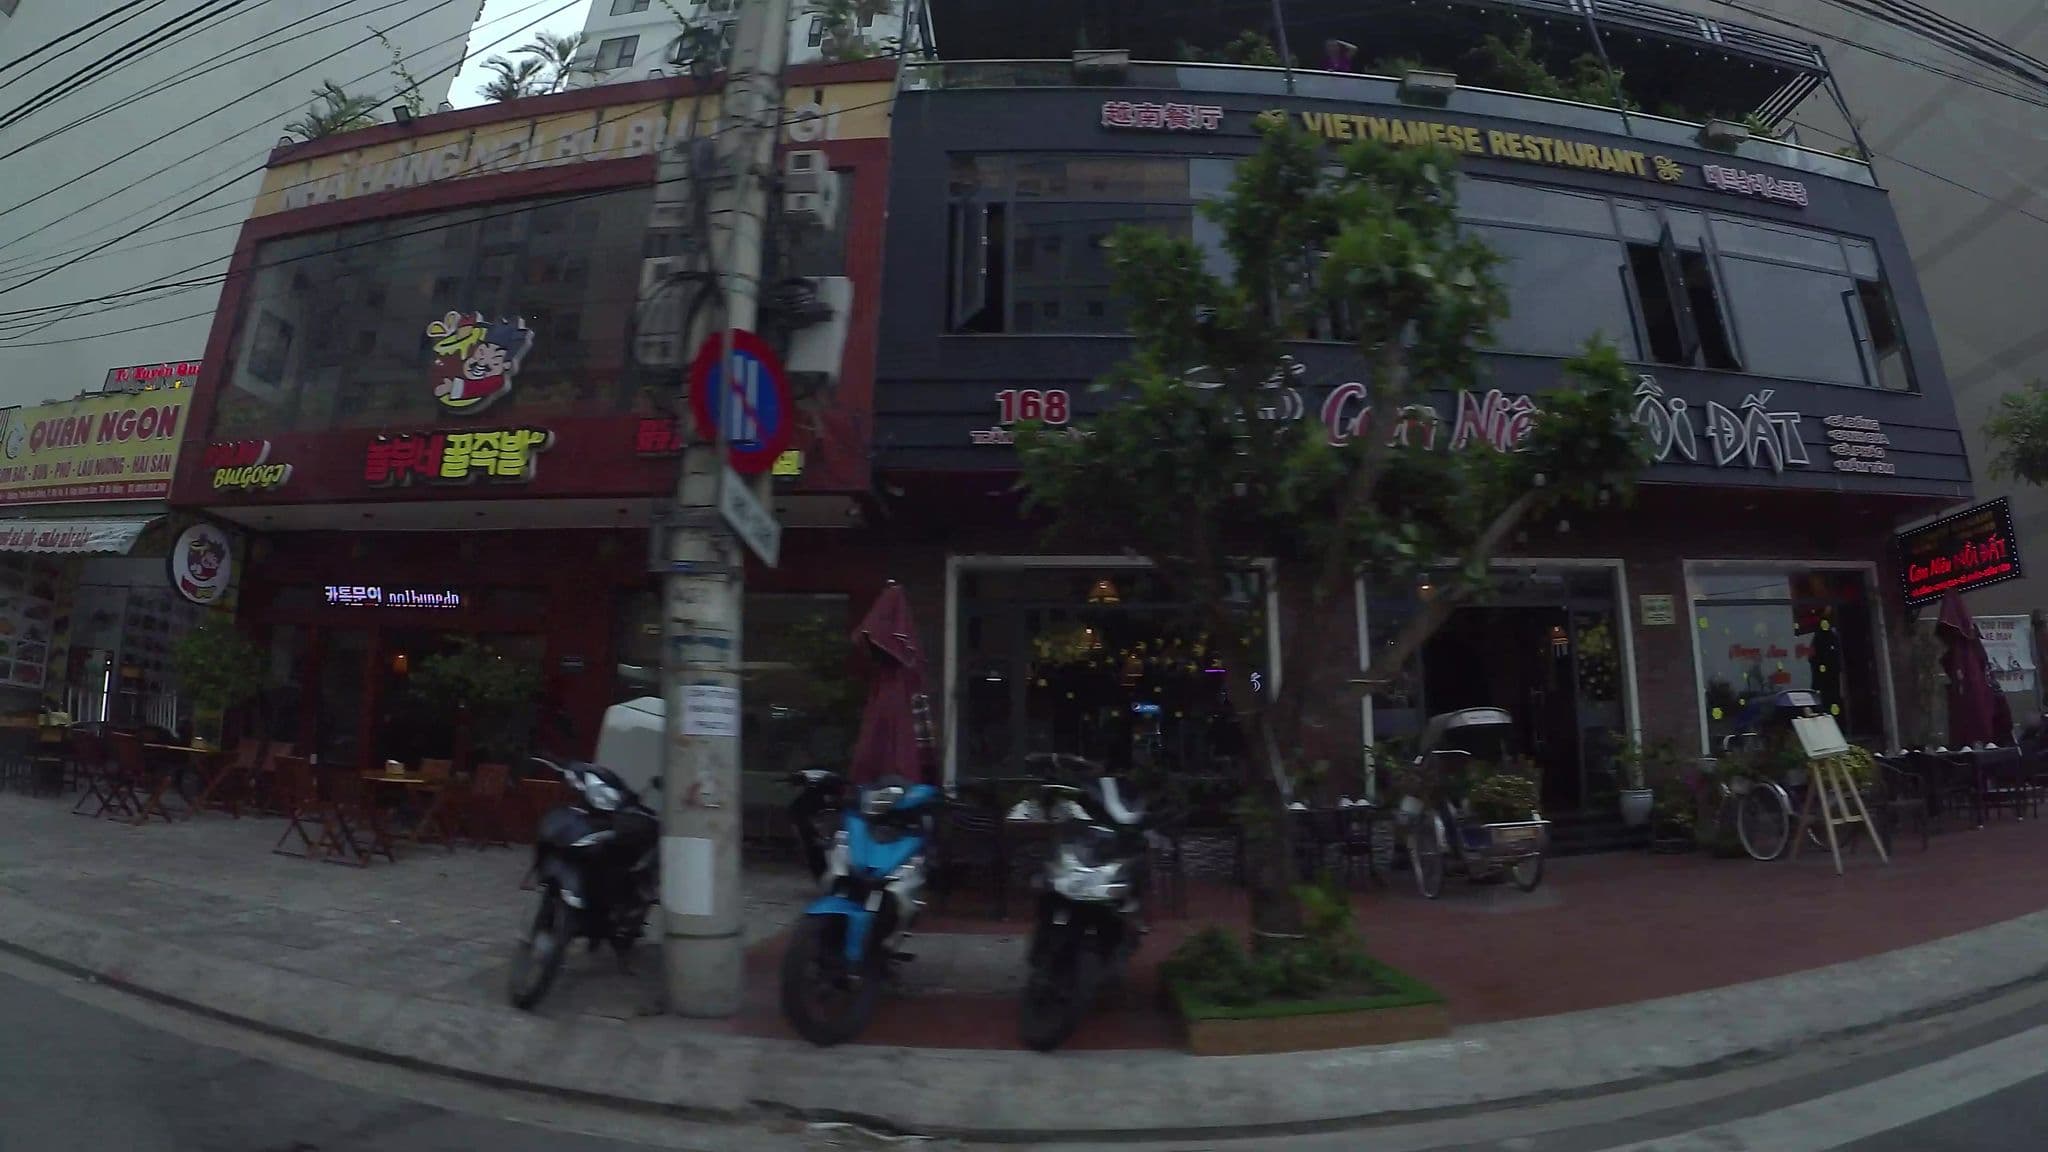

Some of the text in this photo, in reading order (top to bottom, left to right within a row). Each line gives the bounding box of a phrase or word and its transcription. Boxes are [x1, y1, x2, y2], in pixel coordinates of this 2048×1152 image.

[1302, 111, 1648, 177] VIETNAMESE RESTAURANT
[97, 403, 182, 445] NGON
[995, 388, 1071, 425] 168
